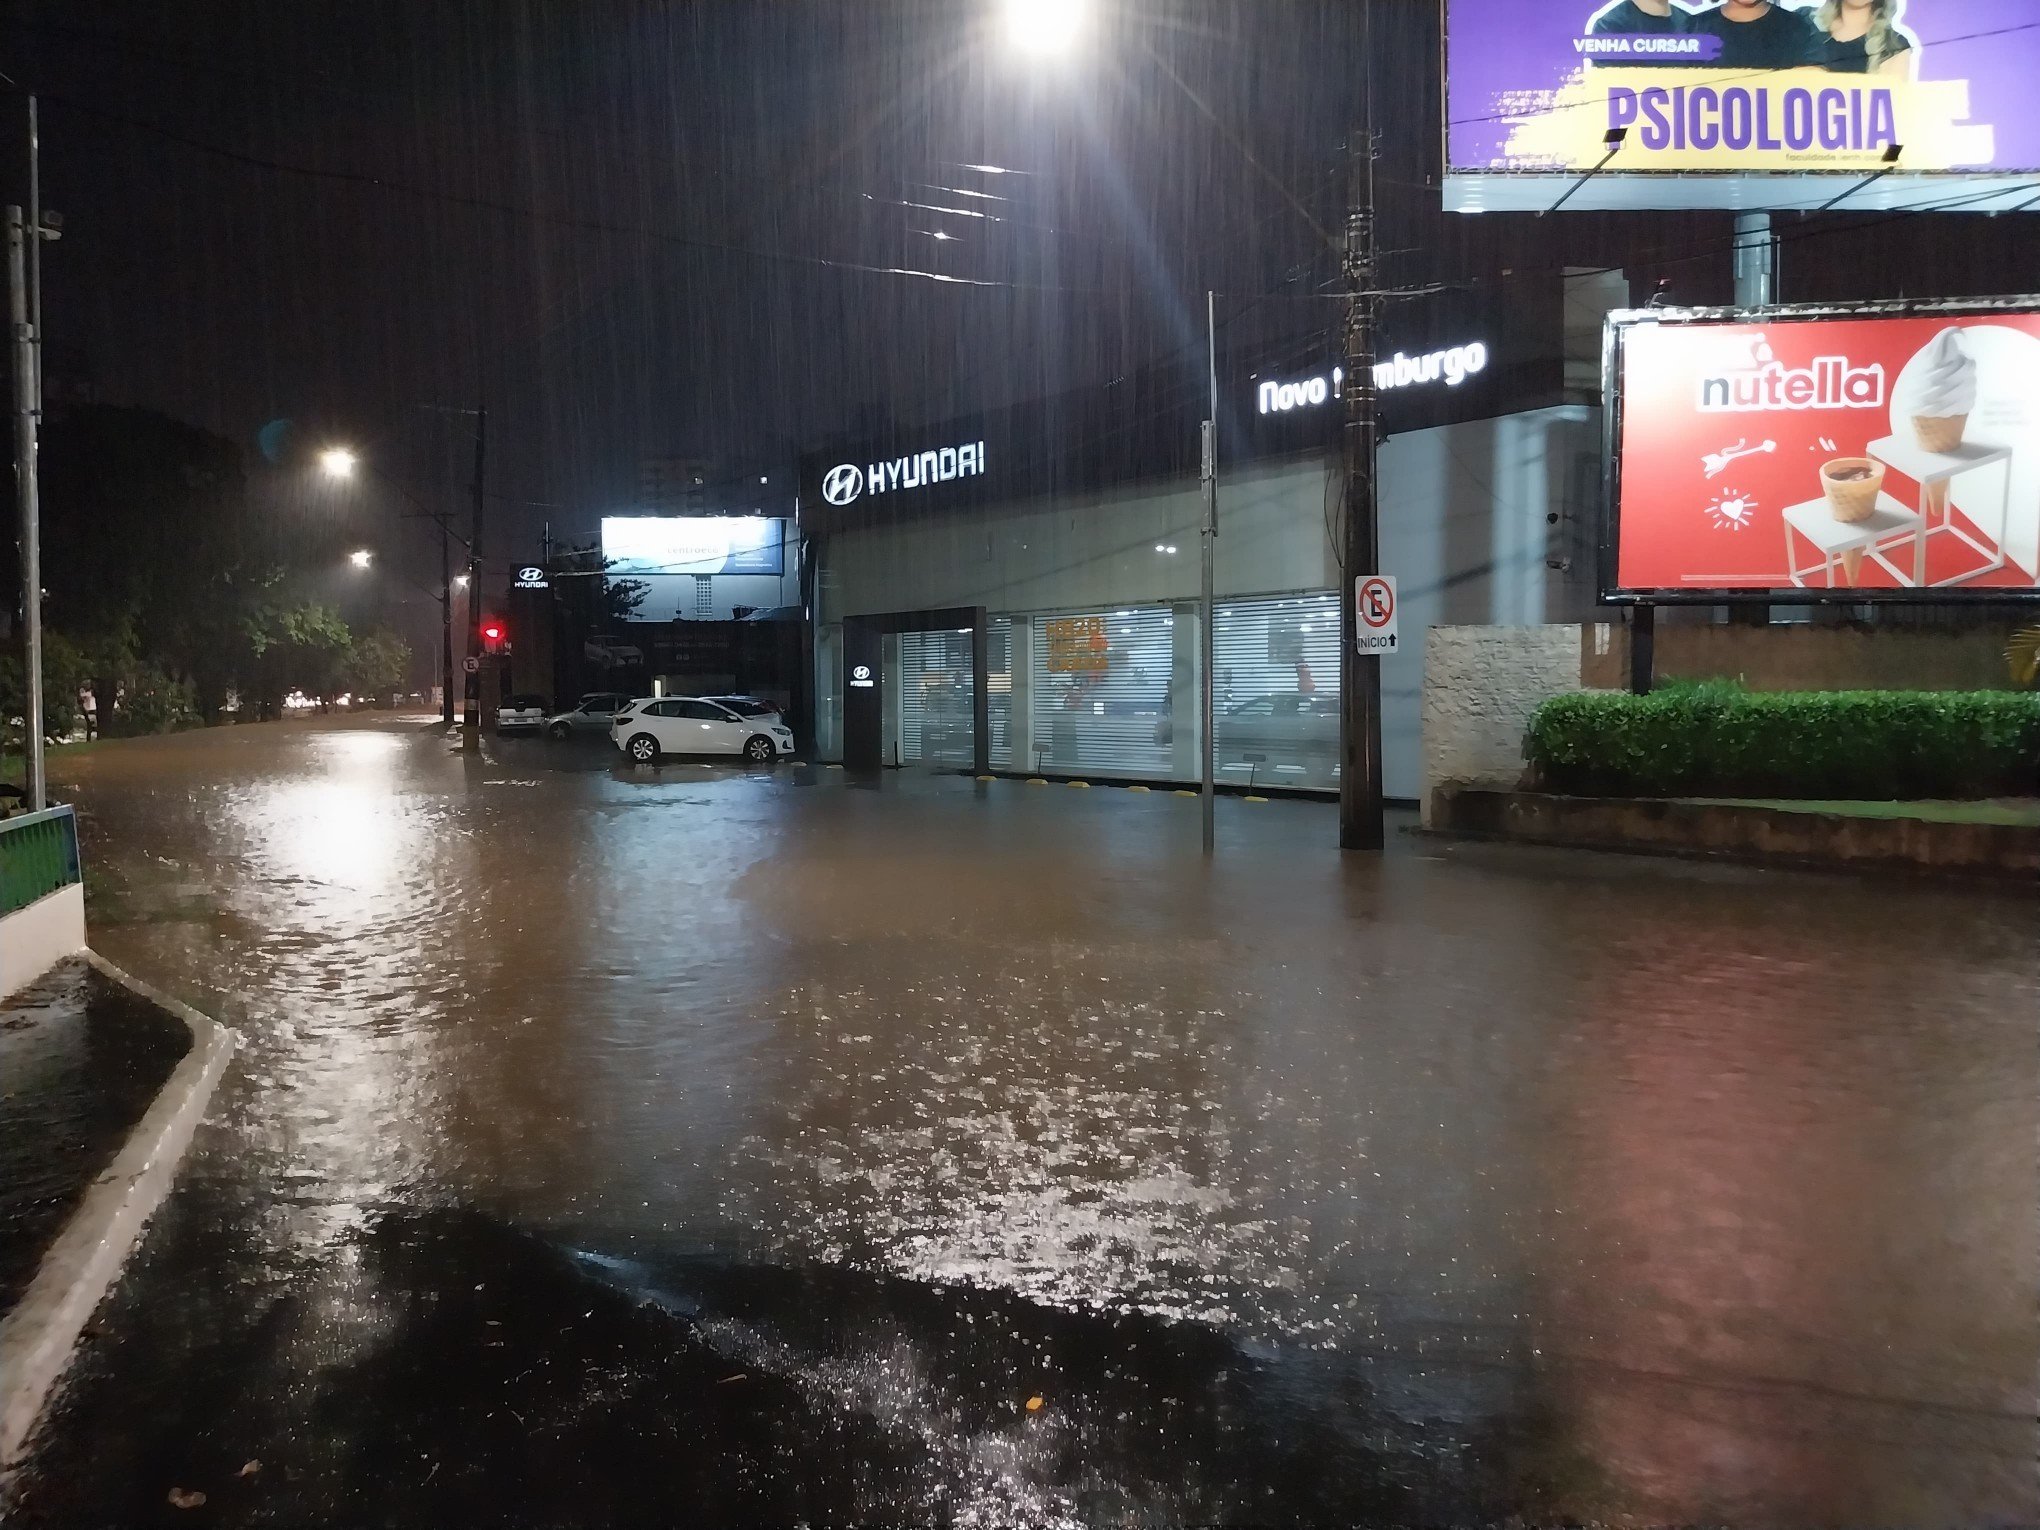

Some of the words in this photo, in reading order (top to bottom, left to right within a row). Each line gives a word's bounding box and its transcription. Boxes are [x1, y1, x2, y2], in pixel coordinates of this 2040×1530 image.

[1573, 39, 1630, 52] VENHA
[1633, 39, 1700, 52] CURSAR
[1608, 86, 1897, 150] PSICOLOGIA
[1703, 367, 1878, 405] nutella
[868, 440, 985, 496] HYUNDAI
